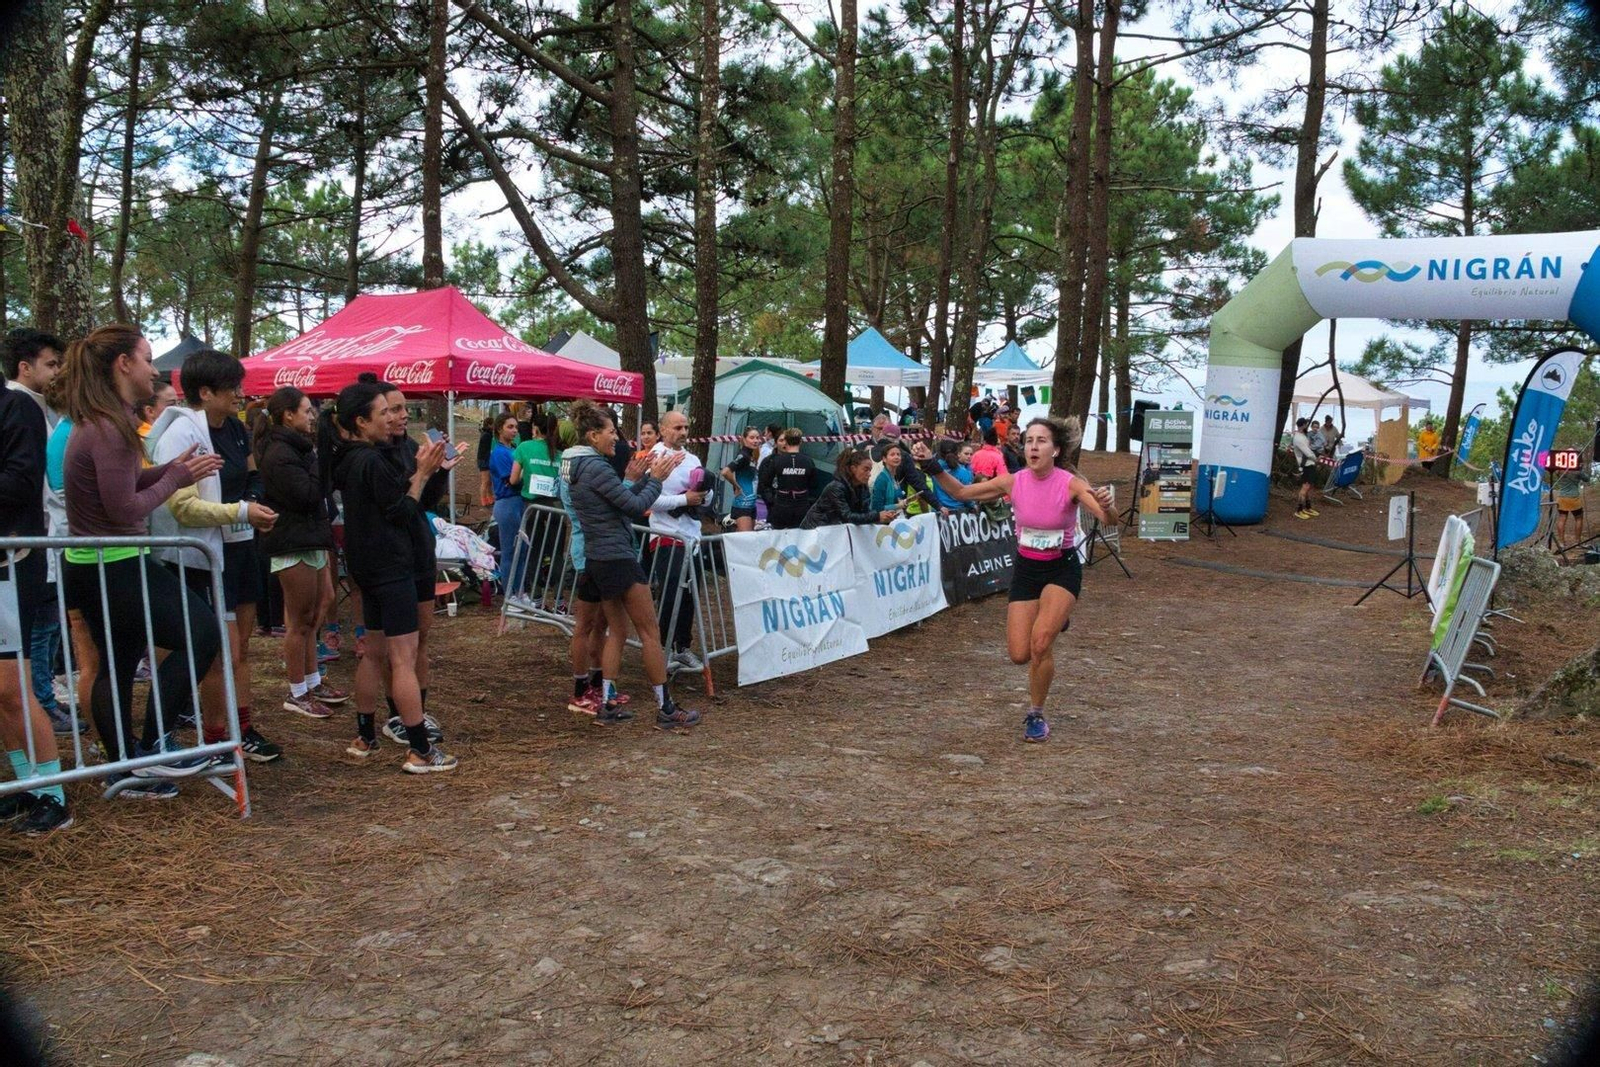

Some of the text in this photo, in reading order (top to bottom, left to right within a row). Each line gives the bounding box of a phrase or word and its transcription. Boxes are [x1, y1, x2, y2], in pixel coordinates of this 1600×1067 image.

[1427, 251, 1562, 281] NIGRÁN
[1471, 286, 1560, 298] Equilibrio Natural
[466, 360, 517, 387] Coca-Cola
[782, 467, 806, 476] MARTA
[967, 554, 1014, 577] ALPINE
[762, 584, 846, 634] NIGRÁN
